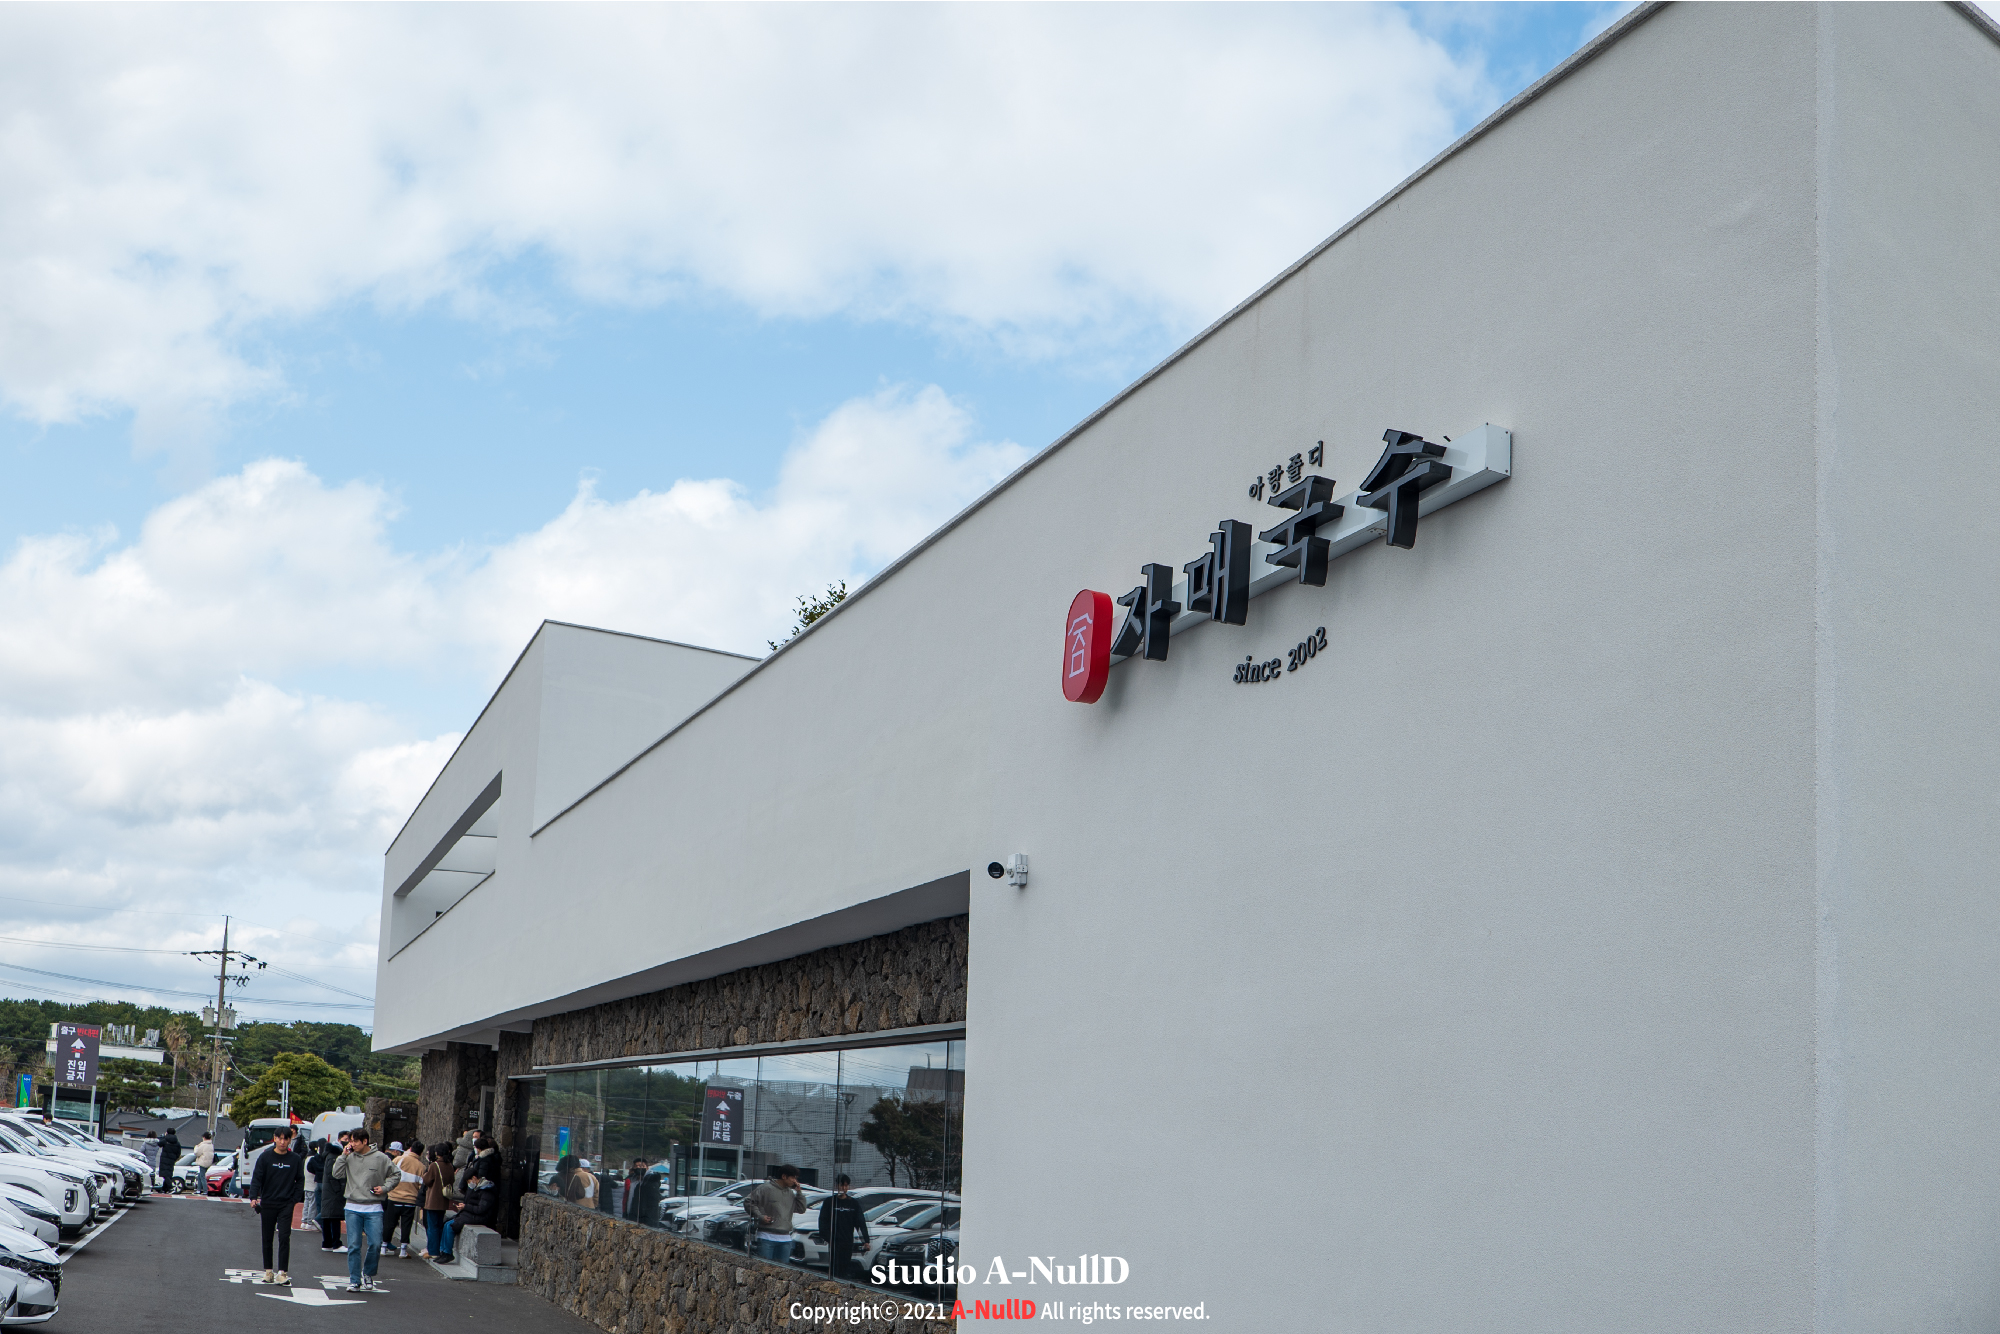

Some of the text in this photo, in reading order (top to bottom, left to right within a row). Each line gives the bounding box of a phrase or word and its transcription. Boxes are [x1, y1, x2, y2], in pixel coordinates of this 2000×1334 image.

[1111, 428, 1452, 661] 자매국수
[1233, 626, 1328, 683] since 2002
[61, 1026, 76, 1035] 출구
[67, 1059, 87, 1071] 진입
[66, 1070, 86, 1082] 금지
